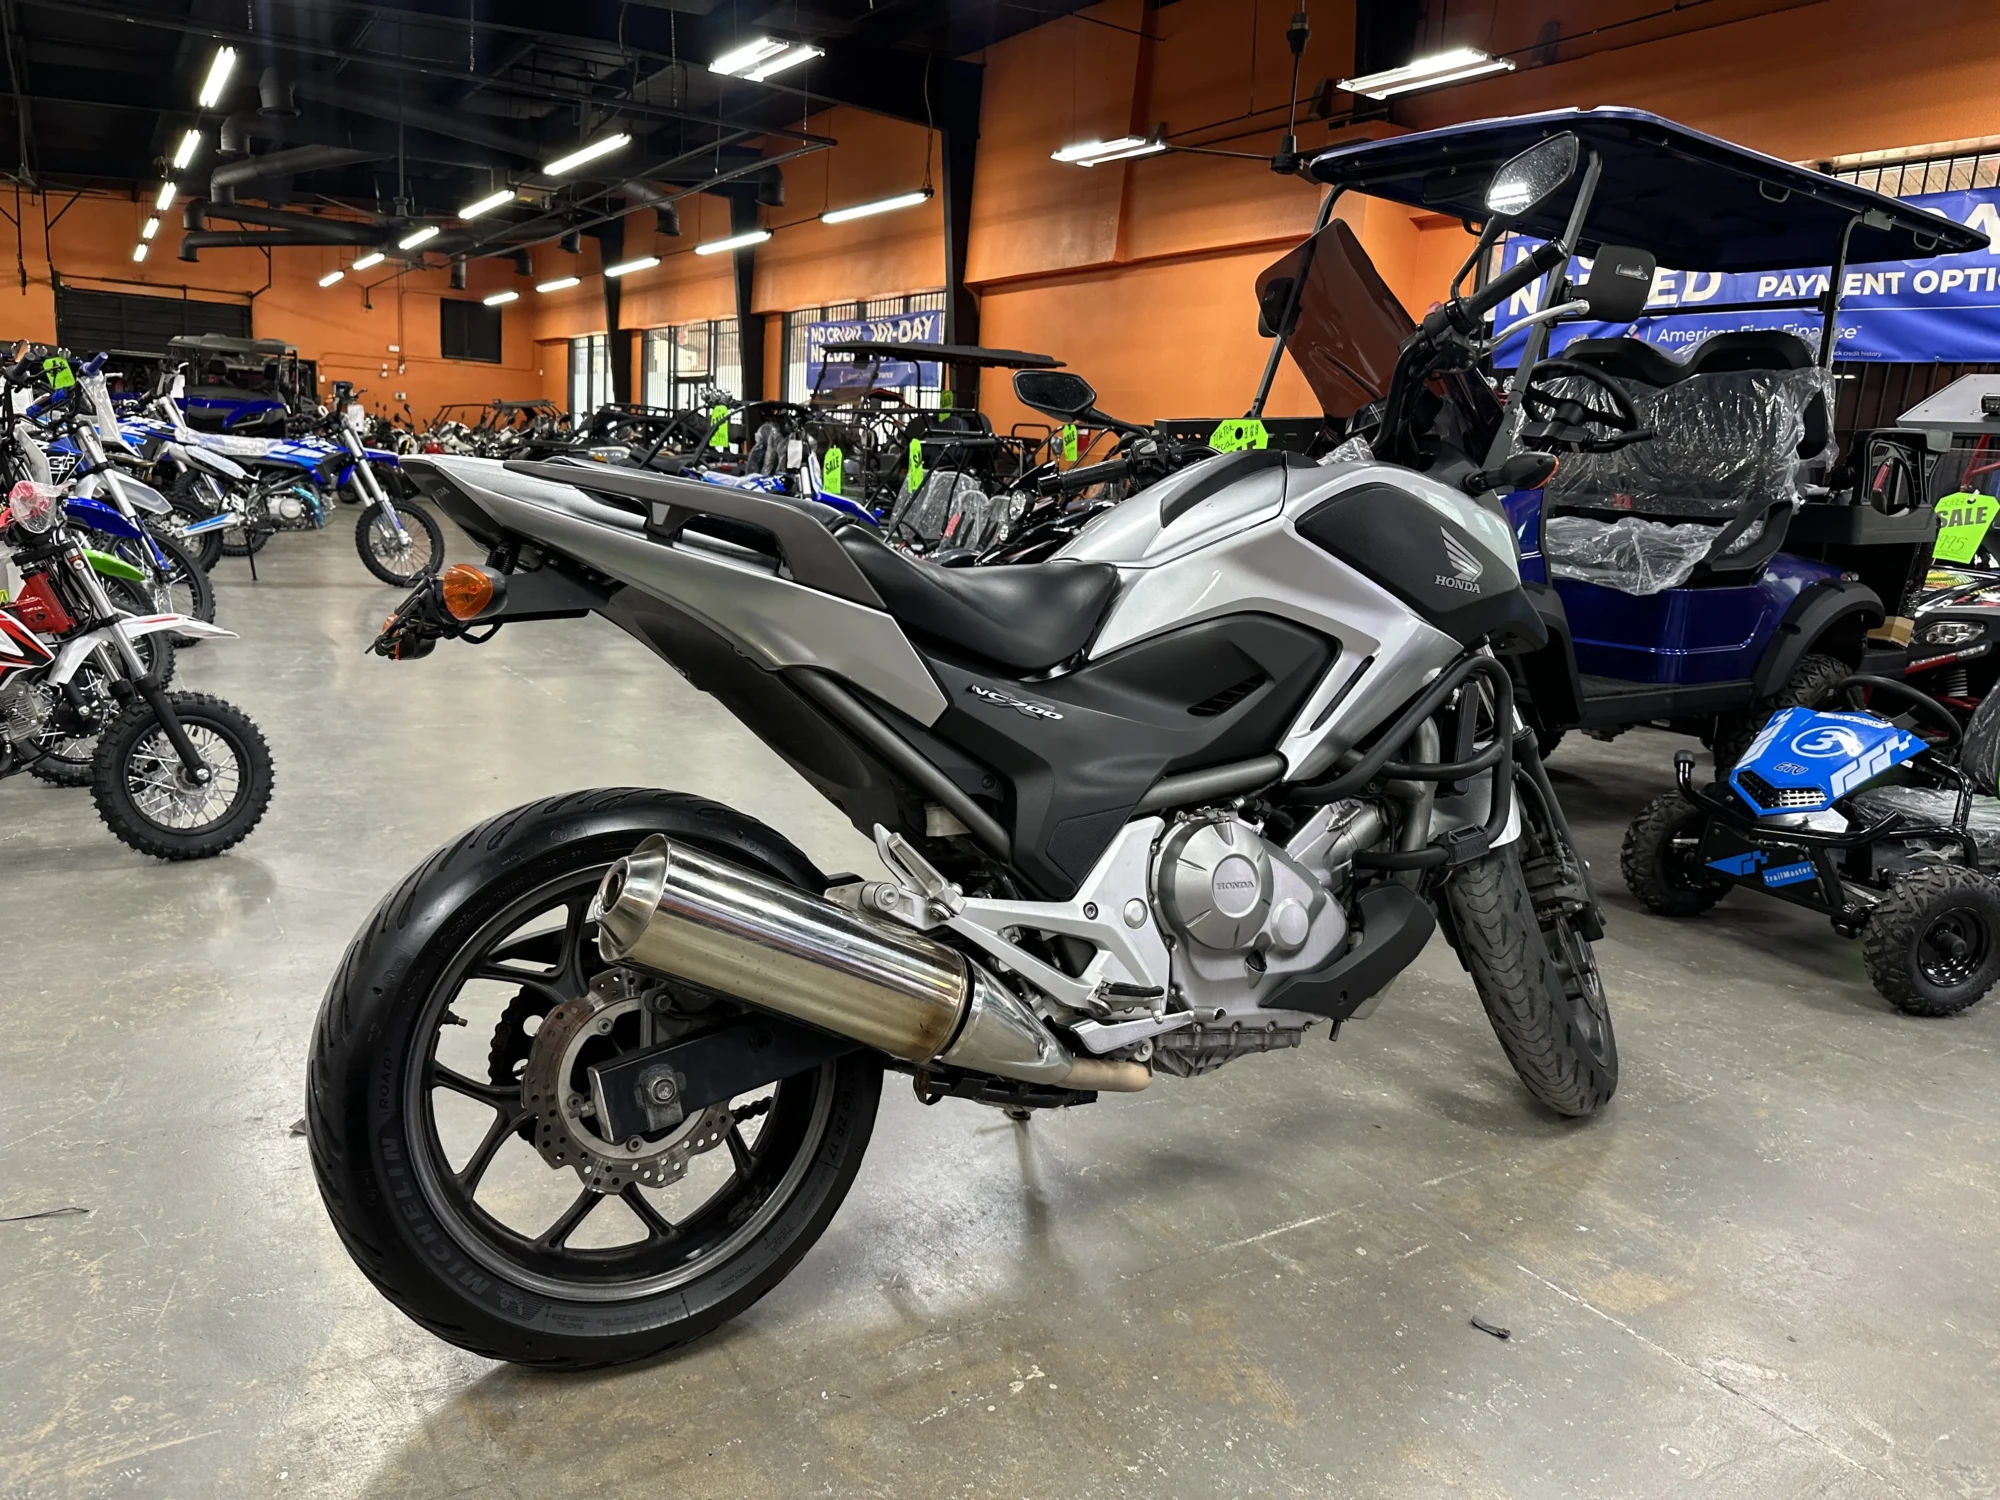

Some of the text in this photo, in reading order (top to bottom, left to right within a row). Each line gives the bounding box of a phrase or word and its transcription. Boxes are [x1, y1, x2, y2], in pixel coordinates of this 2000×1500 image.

[1912, 266, 2000, 295] OPTI
[1064, 430, 1076, 446] SALE
[825, 456, 840, 475] SALE
[1936, 506, 1989, 529] SALE
[1434, 574, 1481, 594] HONDA
[1764, 865, 1812, 883] TrailMaster
[1215, 880, 1255, 890] HONDA
[379, 1058, 393, 1110] ROAD
[380, 1137, 492, 1296] MICHELIN
